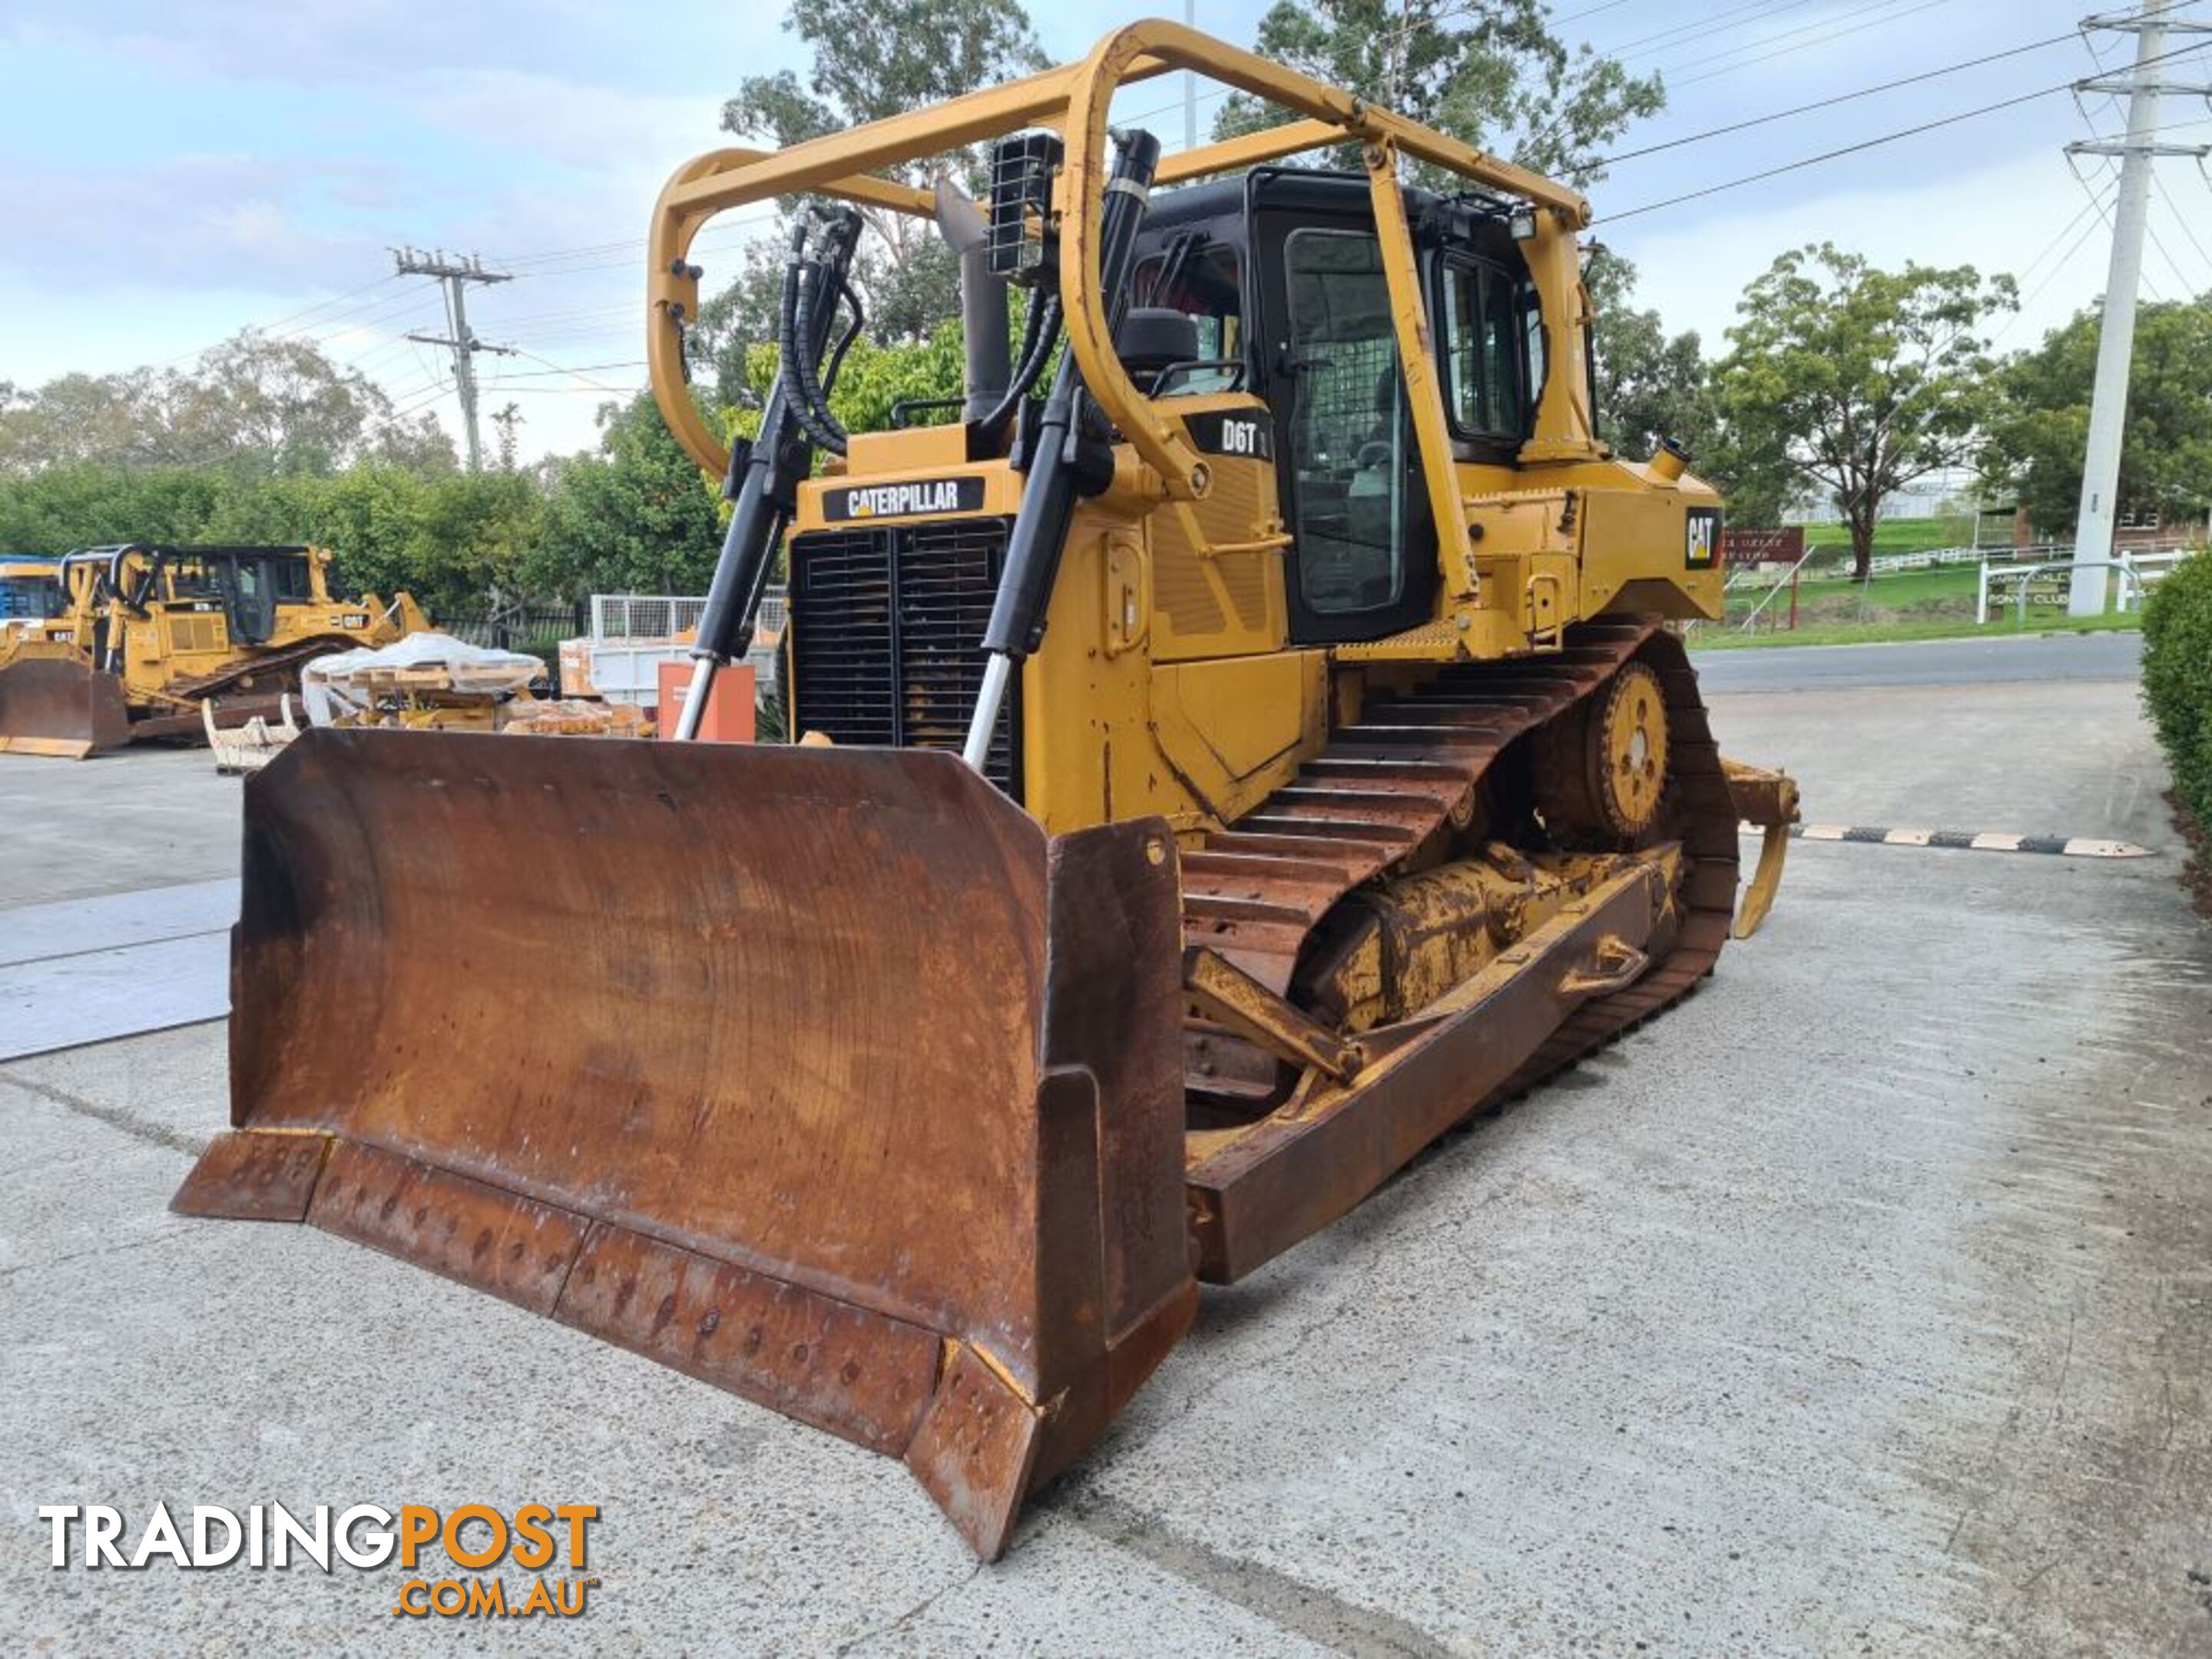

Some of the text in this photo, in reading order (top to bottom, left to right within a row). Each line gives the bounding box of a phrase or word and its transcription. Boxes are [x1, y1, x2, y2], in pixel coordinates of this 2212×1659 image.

[1222, 419, 1256, 453] D6T
[848, 482, 958, 517] CATERPILLAR
[1688, 517, 1714, 559] CAT
